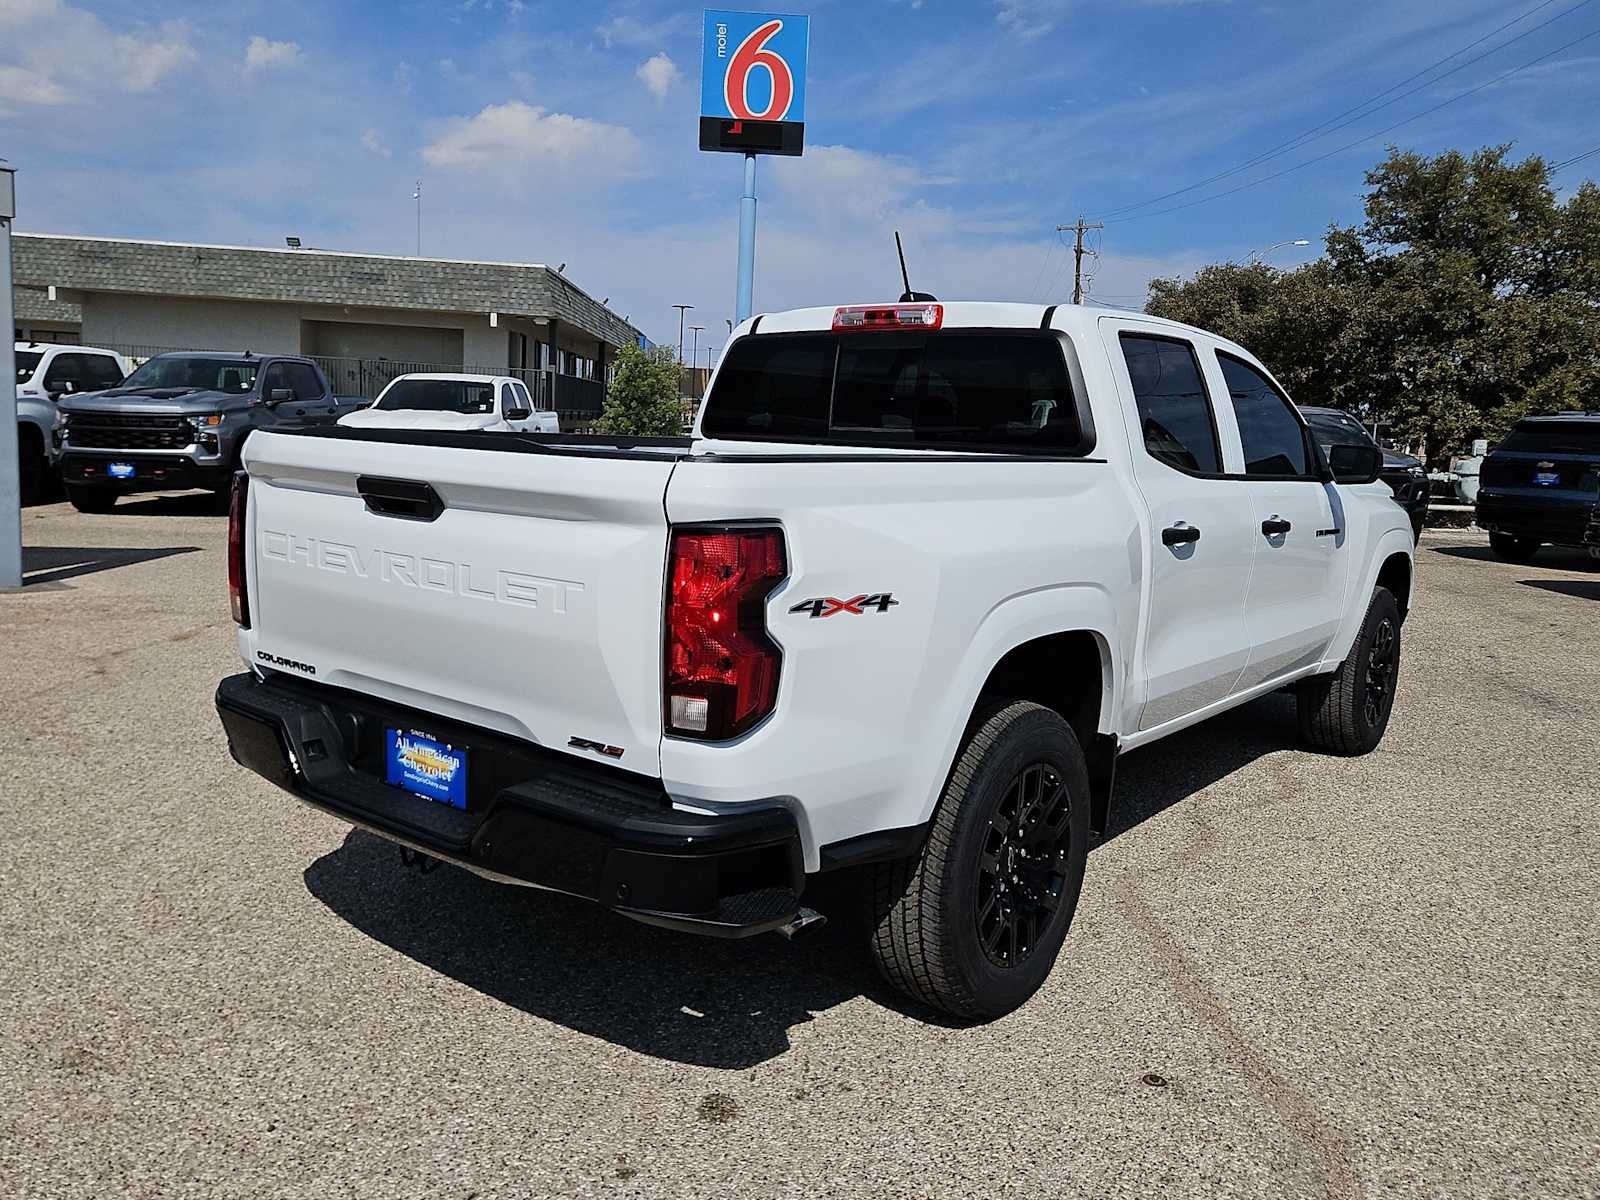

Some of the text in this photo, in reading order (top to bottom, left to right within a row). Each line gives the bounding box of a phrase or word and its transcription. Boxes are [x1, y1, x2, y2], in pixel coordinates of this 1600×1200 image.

[716, 19, 794, 121] motel 6
[262, 529, 586, 615] CHEVROLET
[256, 650, 317, 675] COLORADO
[395, 736, 460, 768] All American
[403, 755, 452, 782] Chevrolet
